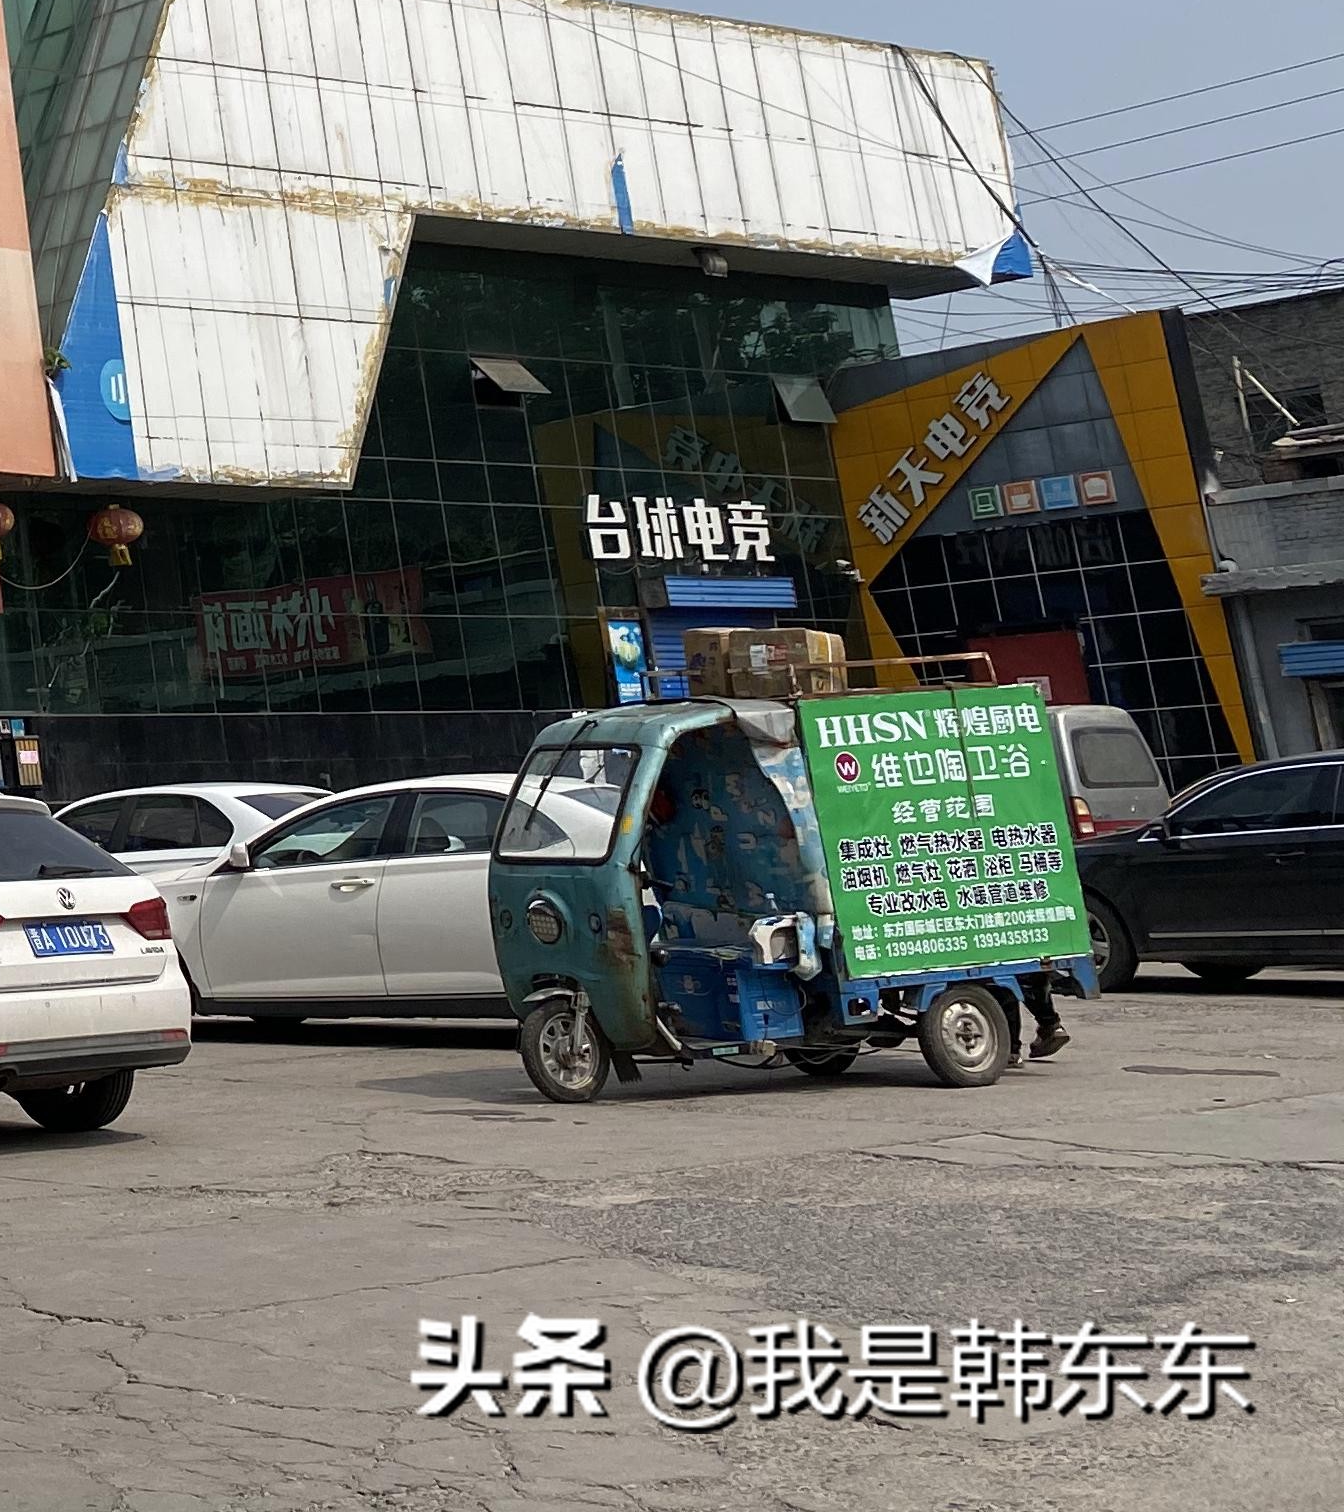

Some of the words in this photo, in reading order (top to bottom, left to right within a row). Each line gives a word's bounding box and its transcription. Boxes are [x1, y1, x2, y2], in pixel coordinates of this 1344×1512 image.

[856, 371, 1012, 545] 新天电竞
[587, 494, 775, 561] 台球电竞
[815, 710, 928, 748] HHSN
[933, 702, 1042, 739] 辉煌厨电
[871, 743, 1031, 789] 维也陶卫浴
[892, 794, 996, 824] 经营范围
[838, 838, 892, 862] 集成灶
[898, 829, 985, 856] 燃气热水器
[990, 823, 1058, 847] 电热水器
[841, 867, 888, 891] 油烟机
[895, 860, 942, 885] 燃气灶
[946, 857, 978, 881] 花洒
[984, 854, 1013, 877] 浴柜
[1019, 851, 1062, 875] 马桶等
[867, 889, 950, 916] 专业改水电
[957, 879, 1050, 908] 水暖管道维修
[973, 928, 1049, 949] 13934358133
